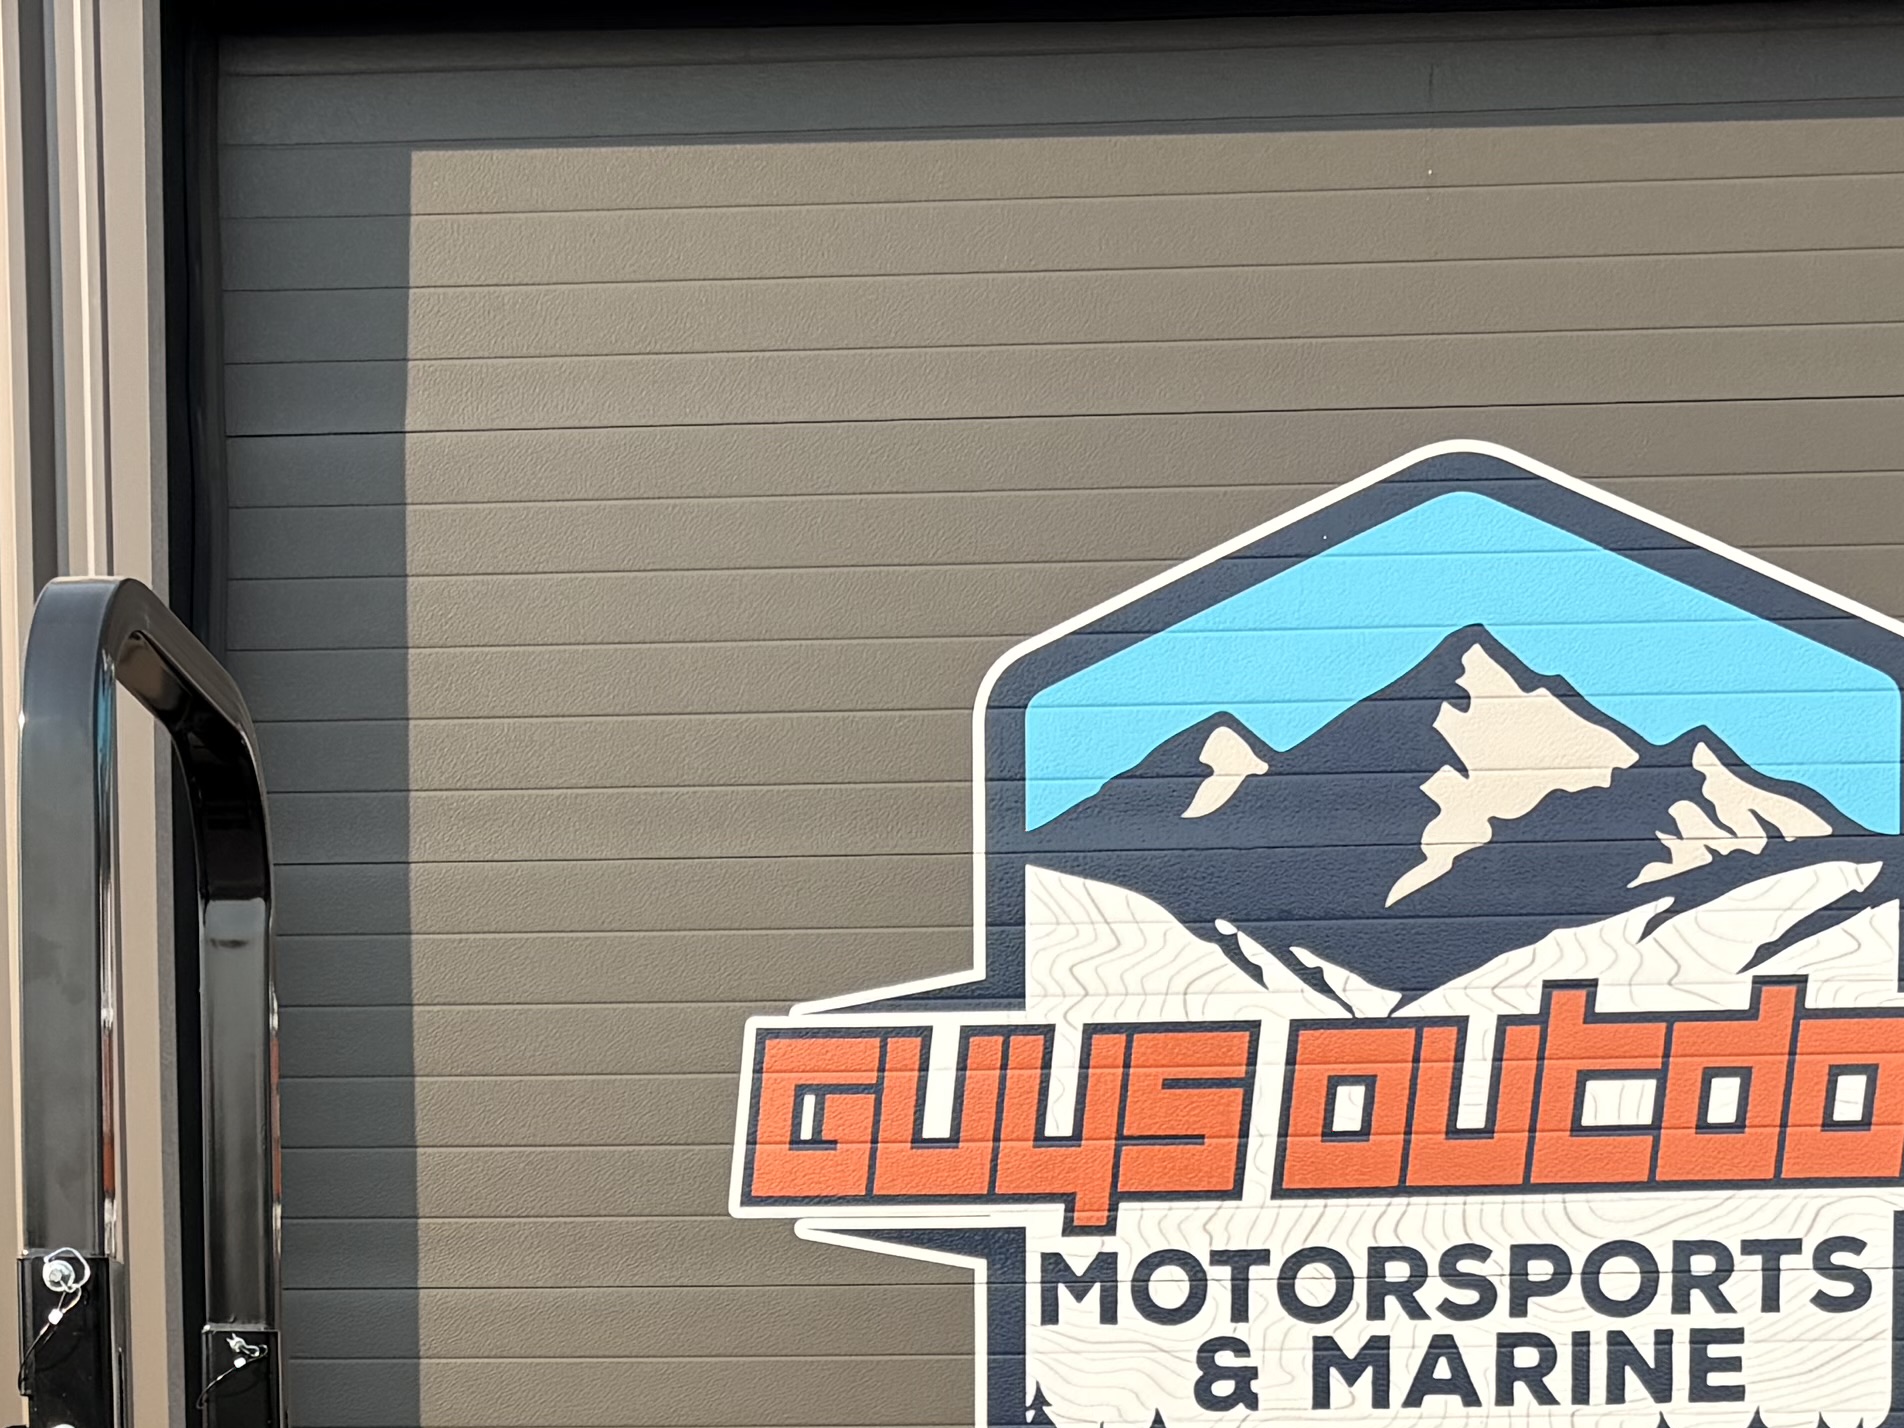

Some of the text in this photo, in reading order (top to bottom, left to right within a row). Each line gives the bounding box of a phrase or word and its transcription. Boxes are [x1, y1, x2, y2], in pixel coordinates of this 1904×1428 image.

[1039, 1235, 1873, 1326] MOTORSPORTS
[1192, 1327, 1747, 1412] & MARINE
